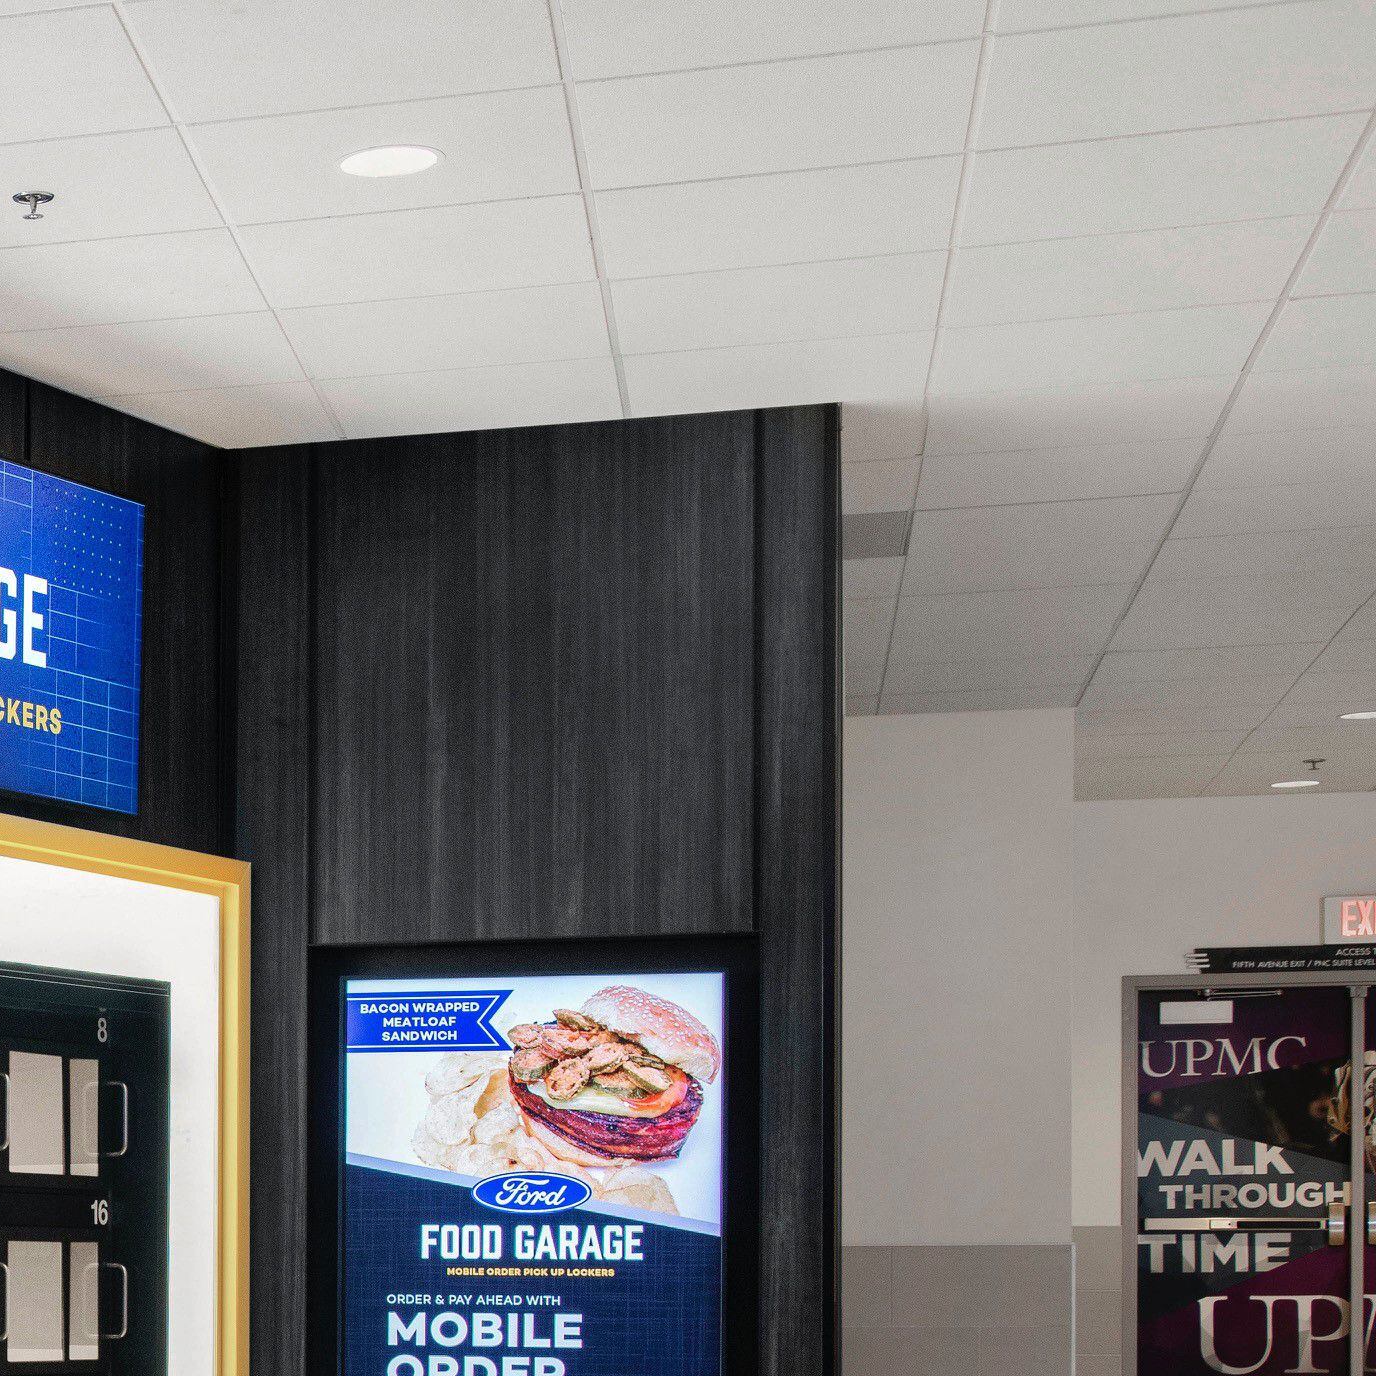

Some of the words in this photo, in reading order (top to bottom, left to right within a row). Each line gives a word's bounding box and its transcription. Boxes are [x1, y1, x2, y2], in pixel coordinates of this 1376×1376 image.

[1335, 948, 1371, 956] ACCESS
[360, 1003, 409, 1013] BACON
[413, 1002, 480, 1013] WRAPPED
[97, 1018, 108, 1042] 8
[383, 1016, 456, 1027] MEATLOAF
[382, 1030, 457, 1042] SANDWICH
[1140, 1036, 1307, 1077] UPMC
[1137, 1139, 1295, 1177] WALK
[495, 1180, 566, 1205] Ford
[1159, 1182, 1351, 1210] THROUGH
[91, 1200, 109, 1225] 16
[421, 1224, 502, 1259] FOOD
[515, 1225, 644, 1261] GARAGE
[1137, 1232, 1291, 1273] TIME
[447, 1267, 484, 1277] MOBILE
[487, 1267, 521, 1277] ORDER
[524, 1268, 548, 1277] PICK
[551, 1268, 565, 1277] UP
[567, 1268, 615, 1277] LOCKERS
[387, 1294, 431, 1305] ORDER
[435, 1295, 444, 1305] &
[449, 1295, 472, 1305] PAY
[476, 1295, 522, 1306] AHEAD
[526, 1295, 561, 1306] WITH
[387, 1311, 583, 1348] MOBILE
